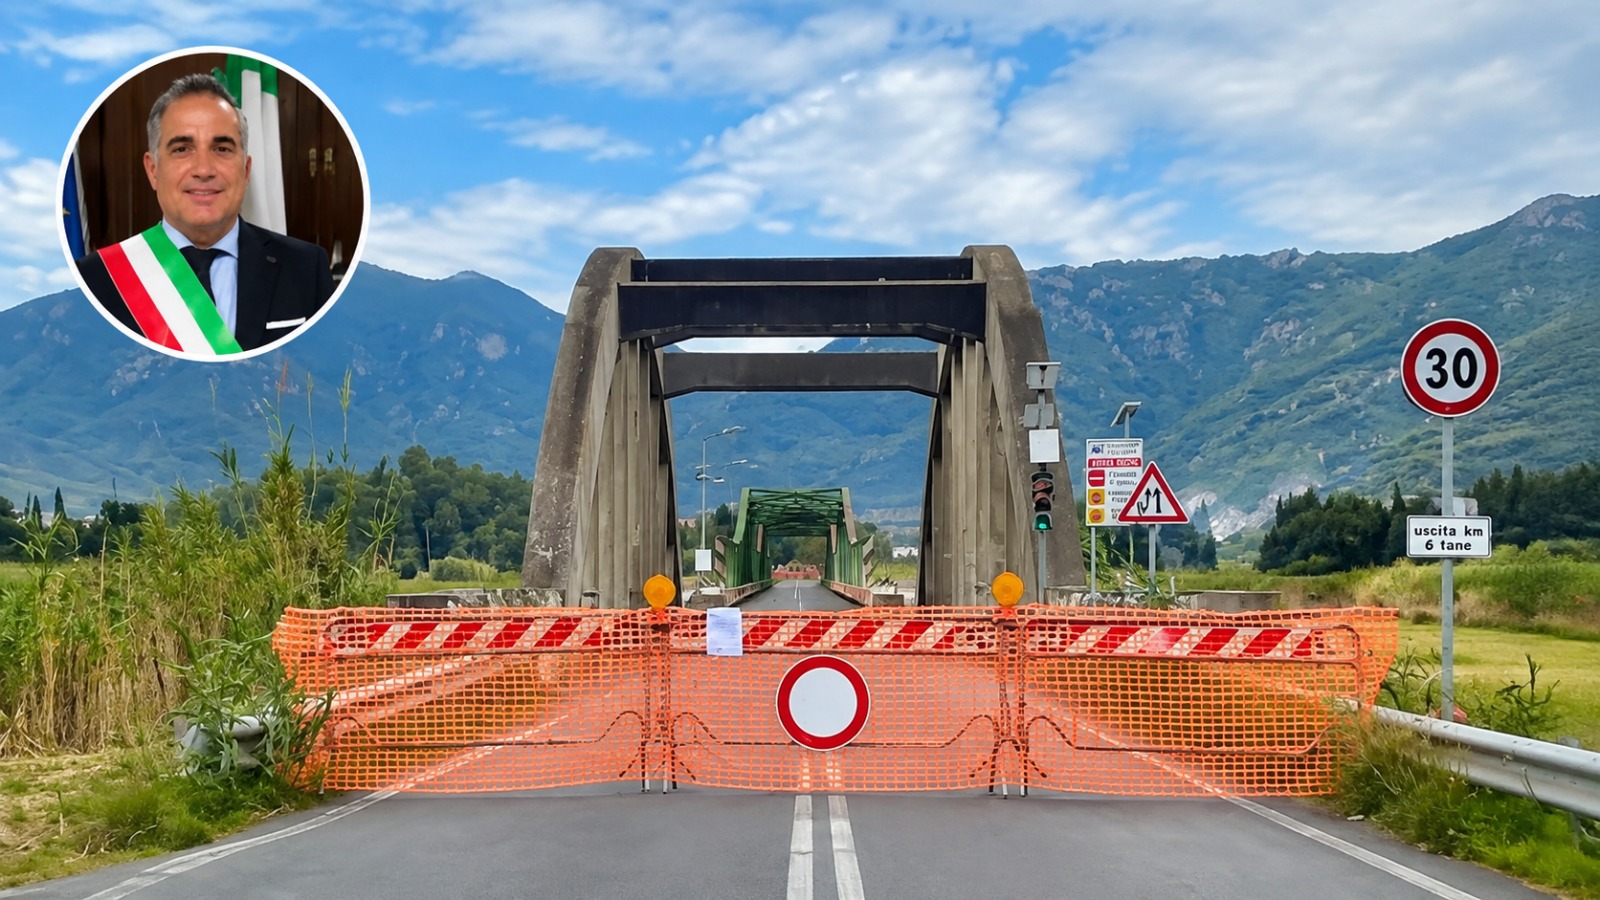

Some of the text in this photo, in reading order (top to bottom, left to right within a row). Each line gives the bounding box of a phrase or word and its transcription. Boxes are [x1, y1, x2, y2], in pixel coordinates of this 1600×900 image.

[1425, 347, 1478, 389] 30
[1414, 525, 1483, 536] uscita km
[1425, 539, 1472, 550] 6 tane
